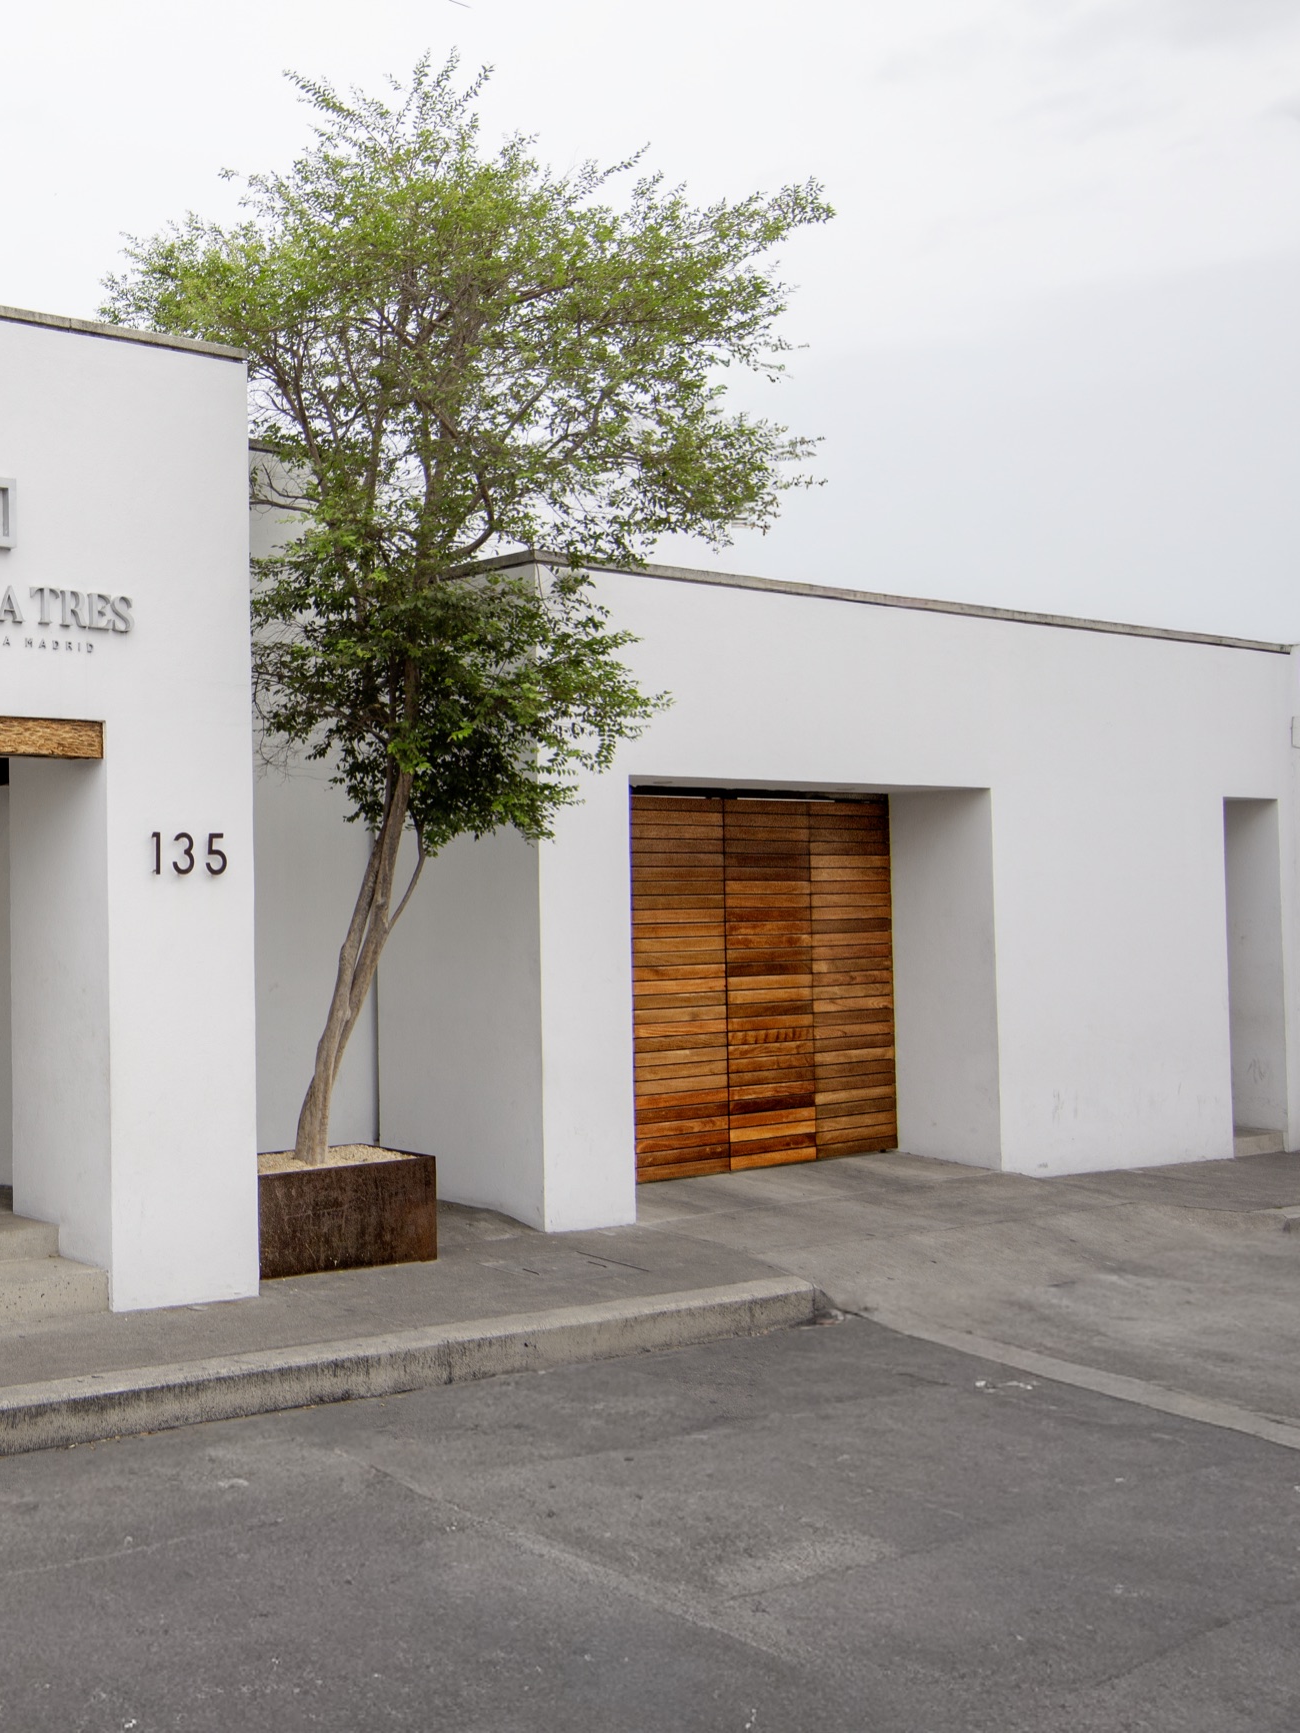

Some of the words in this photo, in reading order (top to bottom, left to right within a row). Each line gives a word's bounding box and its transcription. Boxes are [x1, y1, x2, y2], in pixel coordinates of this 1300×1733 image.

[29, 586, 135, 634] TRES
[24, 637, 94, 654] MADRID
[151, 831, 227, 876] 135
